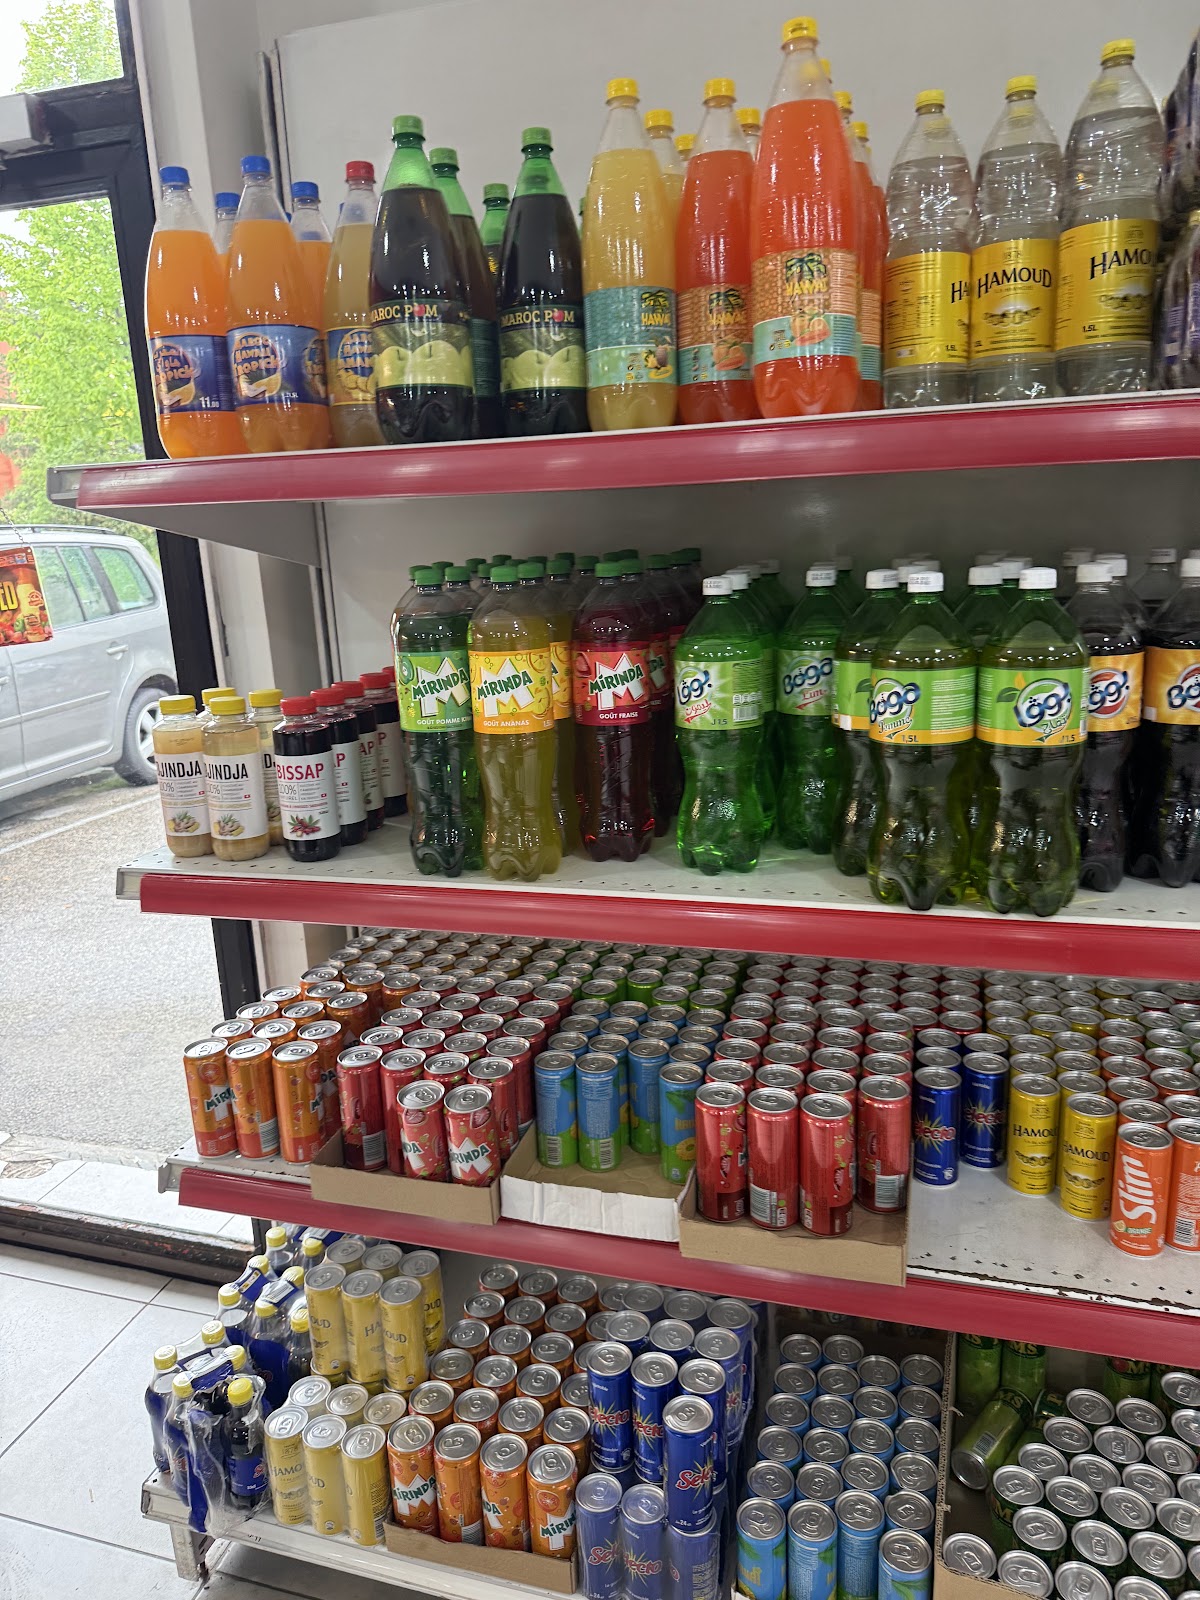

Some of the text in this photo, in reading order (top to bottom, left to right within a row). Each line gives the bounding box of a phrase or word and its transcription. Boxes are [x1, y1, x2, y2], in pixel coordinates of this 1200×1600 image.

[977, 267, 1052, 298] HAMOUD
[501, 719, 530, 727] ANANAS
[277, 763, 324, 780] BISSAP
[1118, 1152, 1157, 1225] Slim
